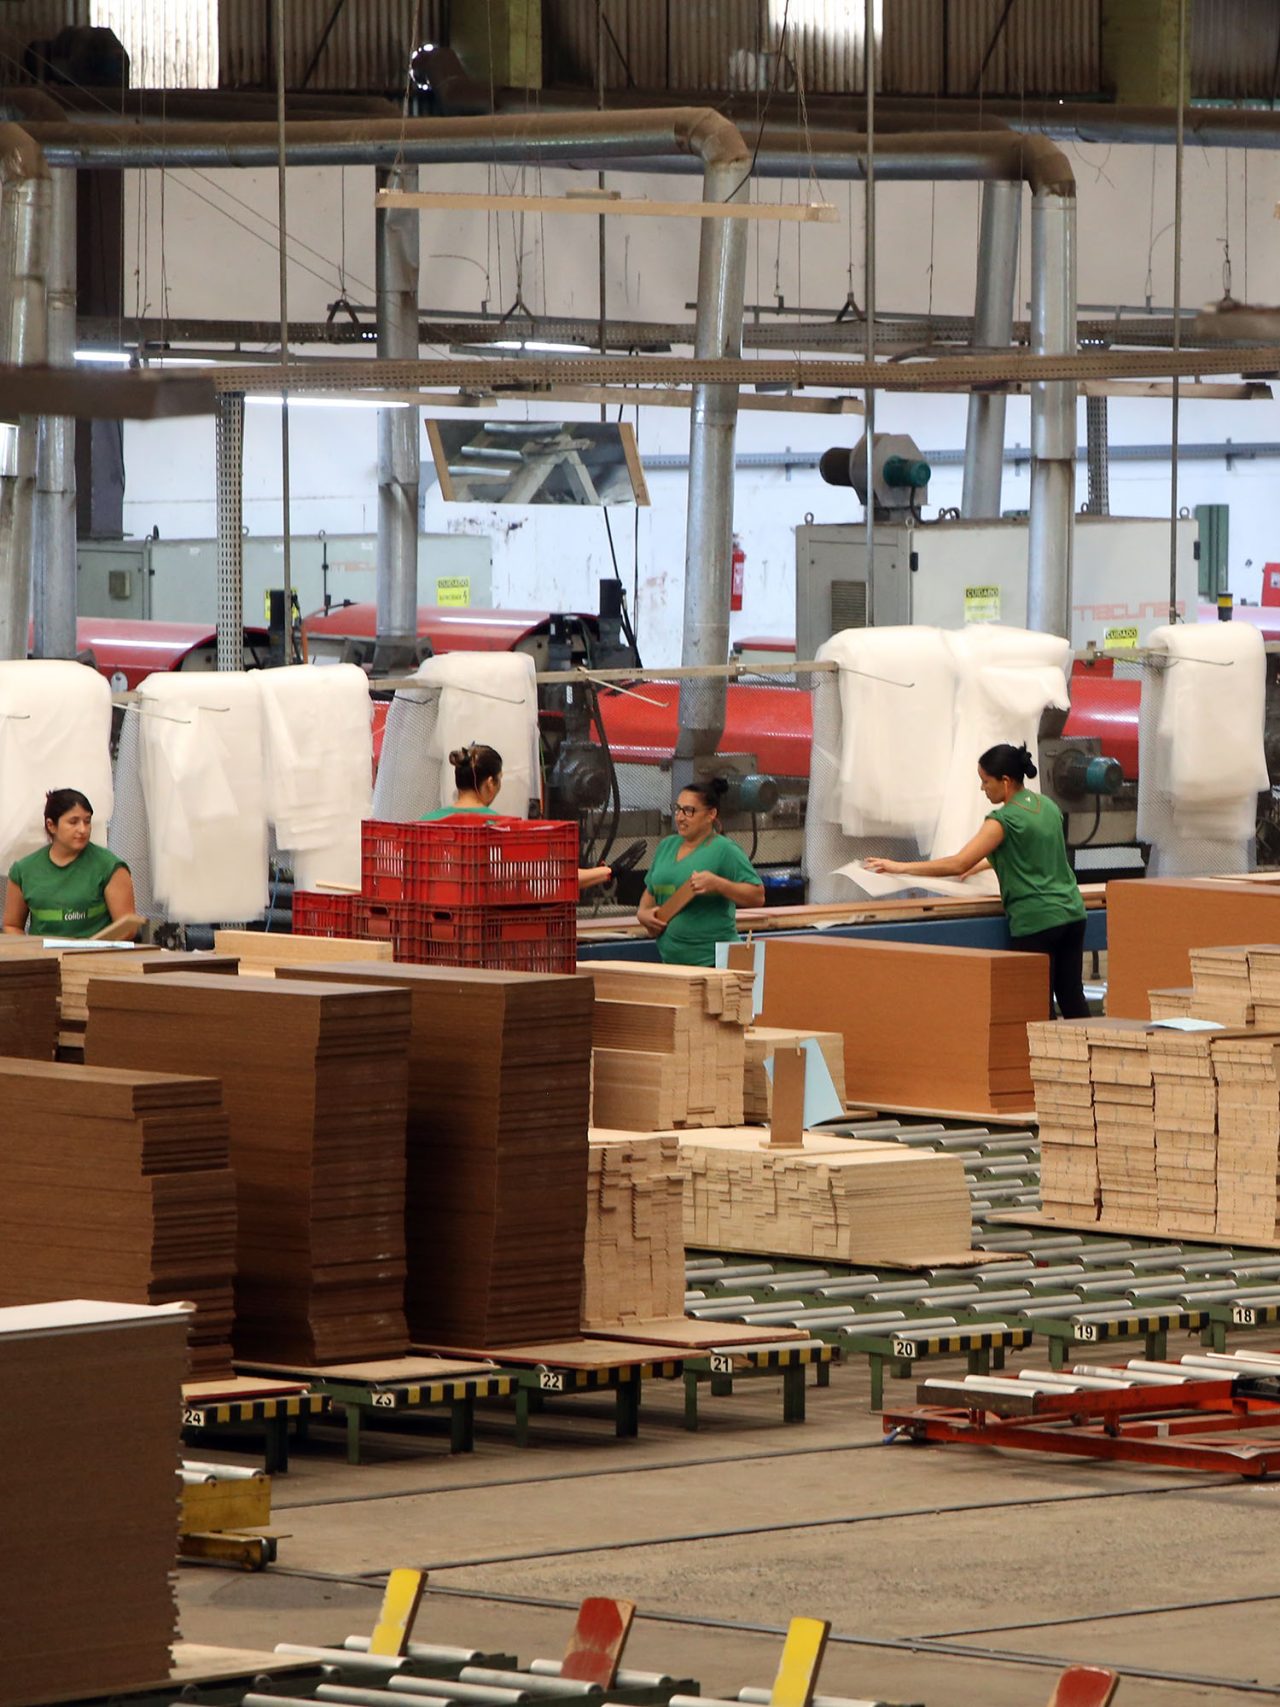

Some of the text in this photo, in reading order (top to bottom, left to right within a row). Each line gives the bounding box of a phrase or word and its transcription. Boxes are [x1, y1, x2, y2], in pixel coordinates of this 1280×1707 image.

[966, 587, 999, 598] CUIDADO
[1105, 629, 1138, 640] CUIDADO
[64, 911, 86, 921] colibri
[1236, 1308, 1252, 1323] 18
[1077, 1325, 1093, 1339] 19
[897, 1342, 913, 1356] 20
[713, 1357, 728, 1372] 21
[543, 1374, 560, 1389] 22
[184, 1410, 201, 1424] 24
